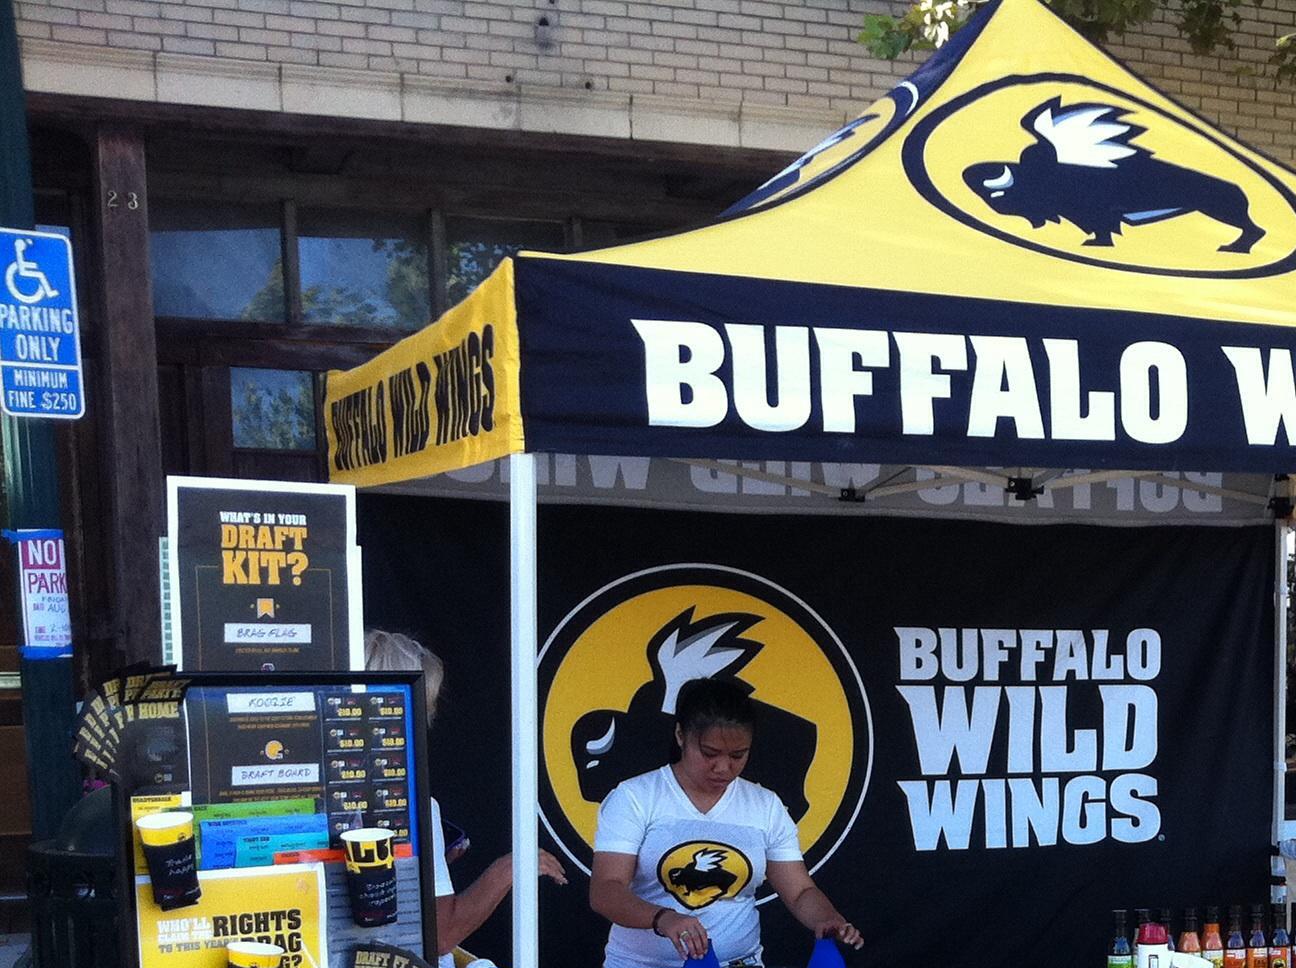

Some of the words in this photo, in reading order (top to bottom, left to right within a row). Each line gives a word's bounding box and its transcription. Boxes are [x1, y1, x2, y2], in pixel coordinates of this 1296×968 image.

[0, 304, 73, 334] PARKING
[16, 334, 61, 361] ONLY
[14, 369, 68, 389] MINIMUM
[630, 318, 1188, 445] BUFFALO
[8, 390, 36, 409] FINE
[41, 393, 77, 411] $250
[331, 380, 388, 471] BUFFALO
[389, 361, 431, 458] WILD
[432, 324, 495, 446] WINGS
[220, 511, 261, 525] WHAT'S
[264, 513, 275, 525] IN
[278, 513, 307, 526] YOUR
[221, 524, 308, 550] DRAFT
[27, 540, 57, 565] NO
[222, 550, 309, 586] KIT?
[236, 628, 266, 639] BRAG
[267, 628, 298, 639] FLAG
[893, 626, 1162, 682] BUFFALO
[138, 701, 180, 719] HOME
[895, 684, 1159, 776] WILD
[241, 769, 275, 780] DRAFT
[896, 773, 1162, 851] WINGS
[212, 909, 301, 938] RIGHTS
[159, 944, 175, 953] TO
[176, 942, 200, 952] THIS
[355, 951, 391, 966] DRAFT
